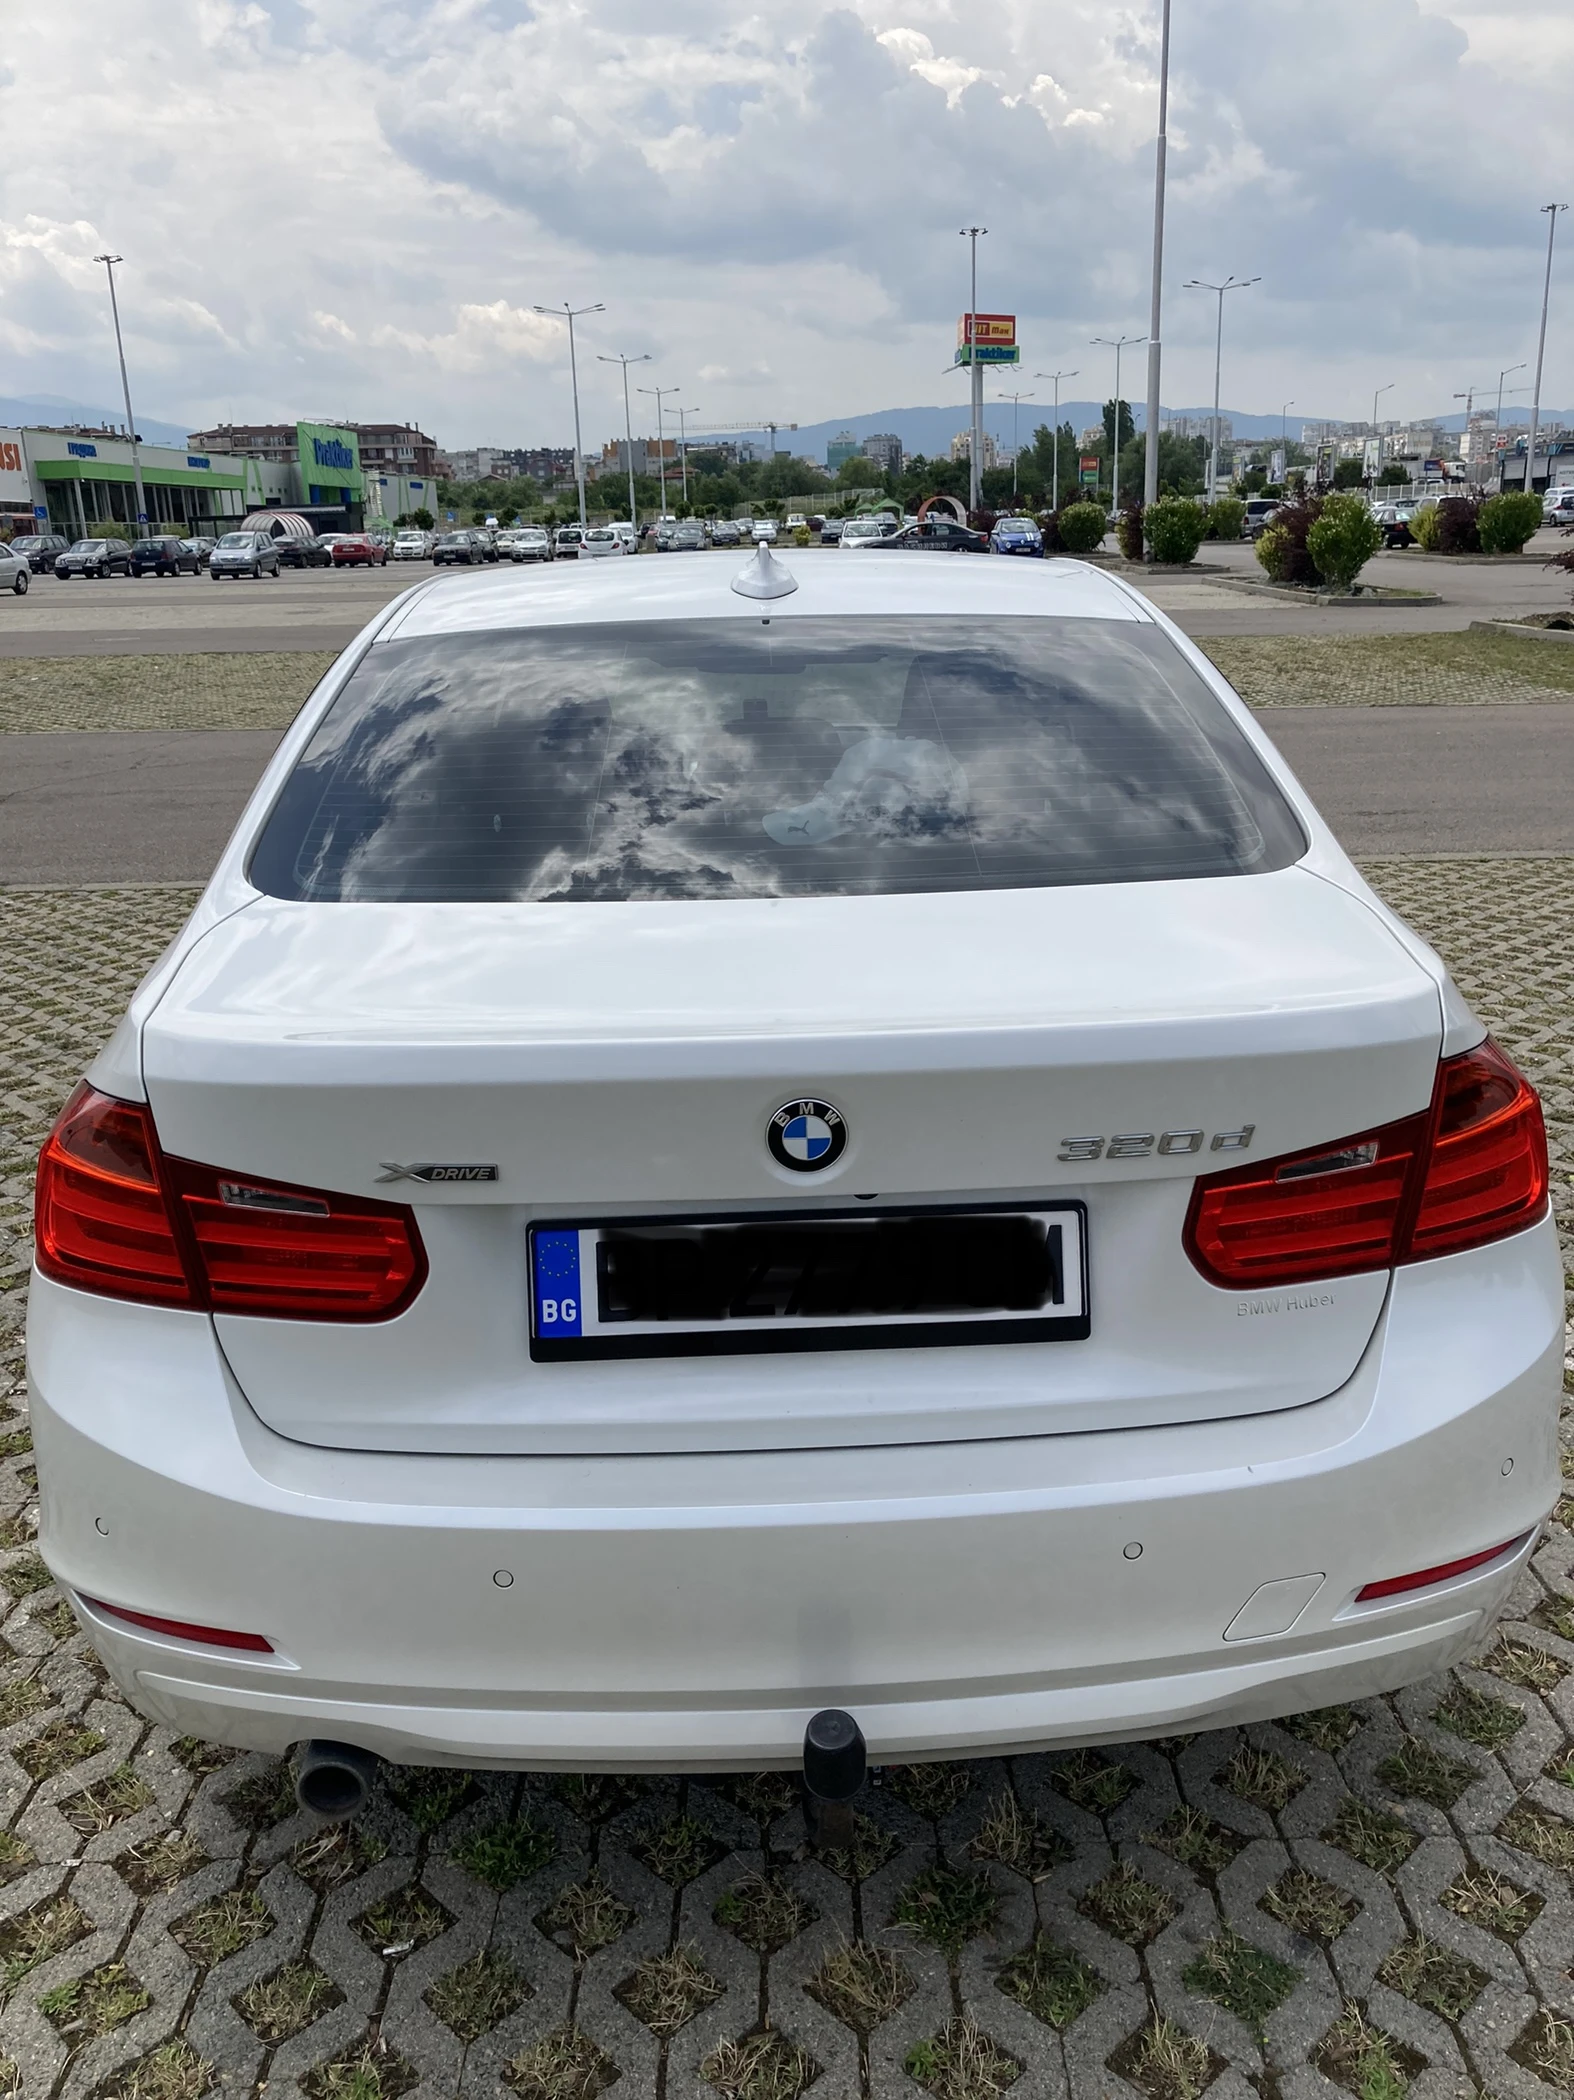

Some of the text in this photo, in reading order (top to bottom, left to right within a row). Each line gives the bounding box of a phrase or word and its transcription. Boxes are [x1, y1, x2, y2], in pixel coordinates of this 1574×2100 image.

[774, 1102, 841, 1127] BMW
[542, 1298, 577, 1323] BG
[1237, 1293, 1336, 1317] BMW Huber
